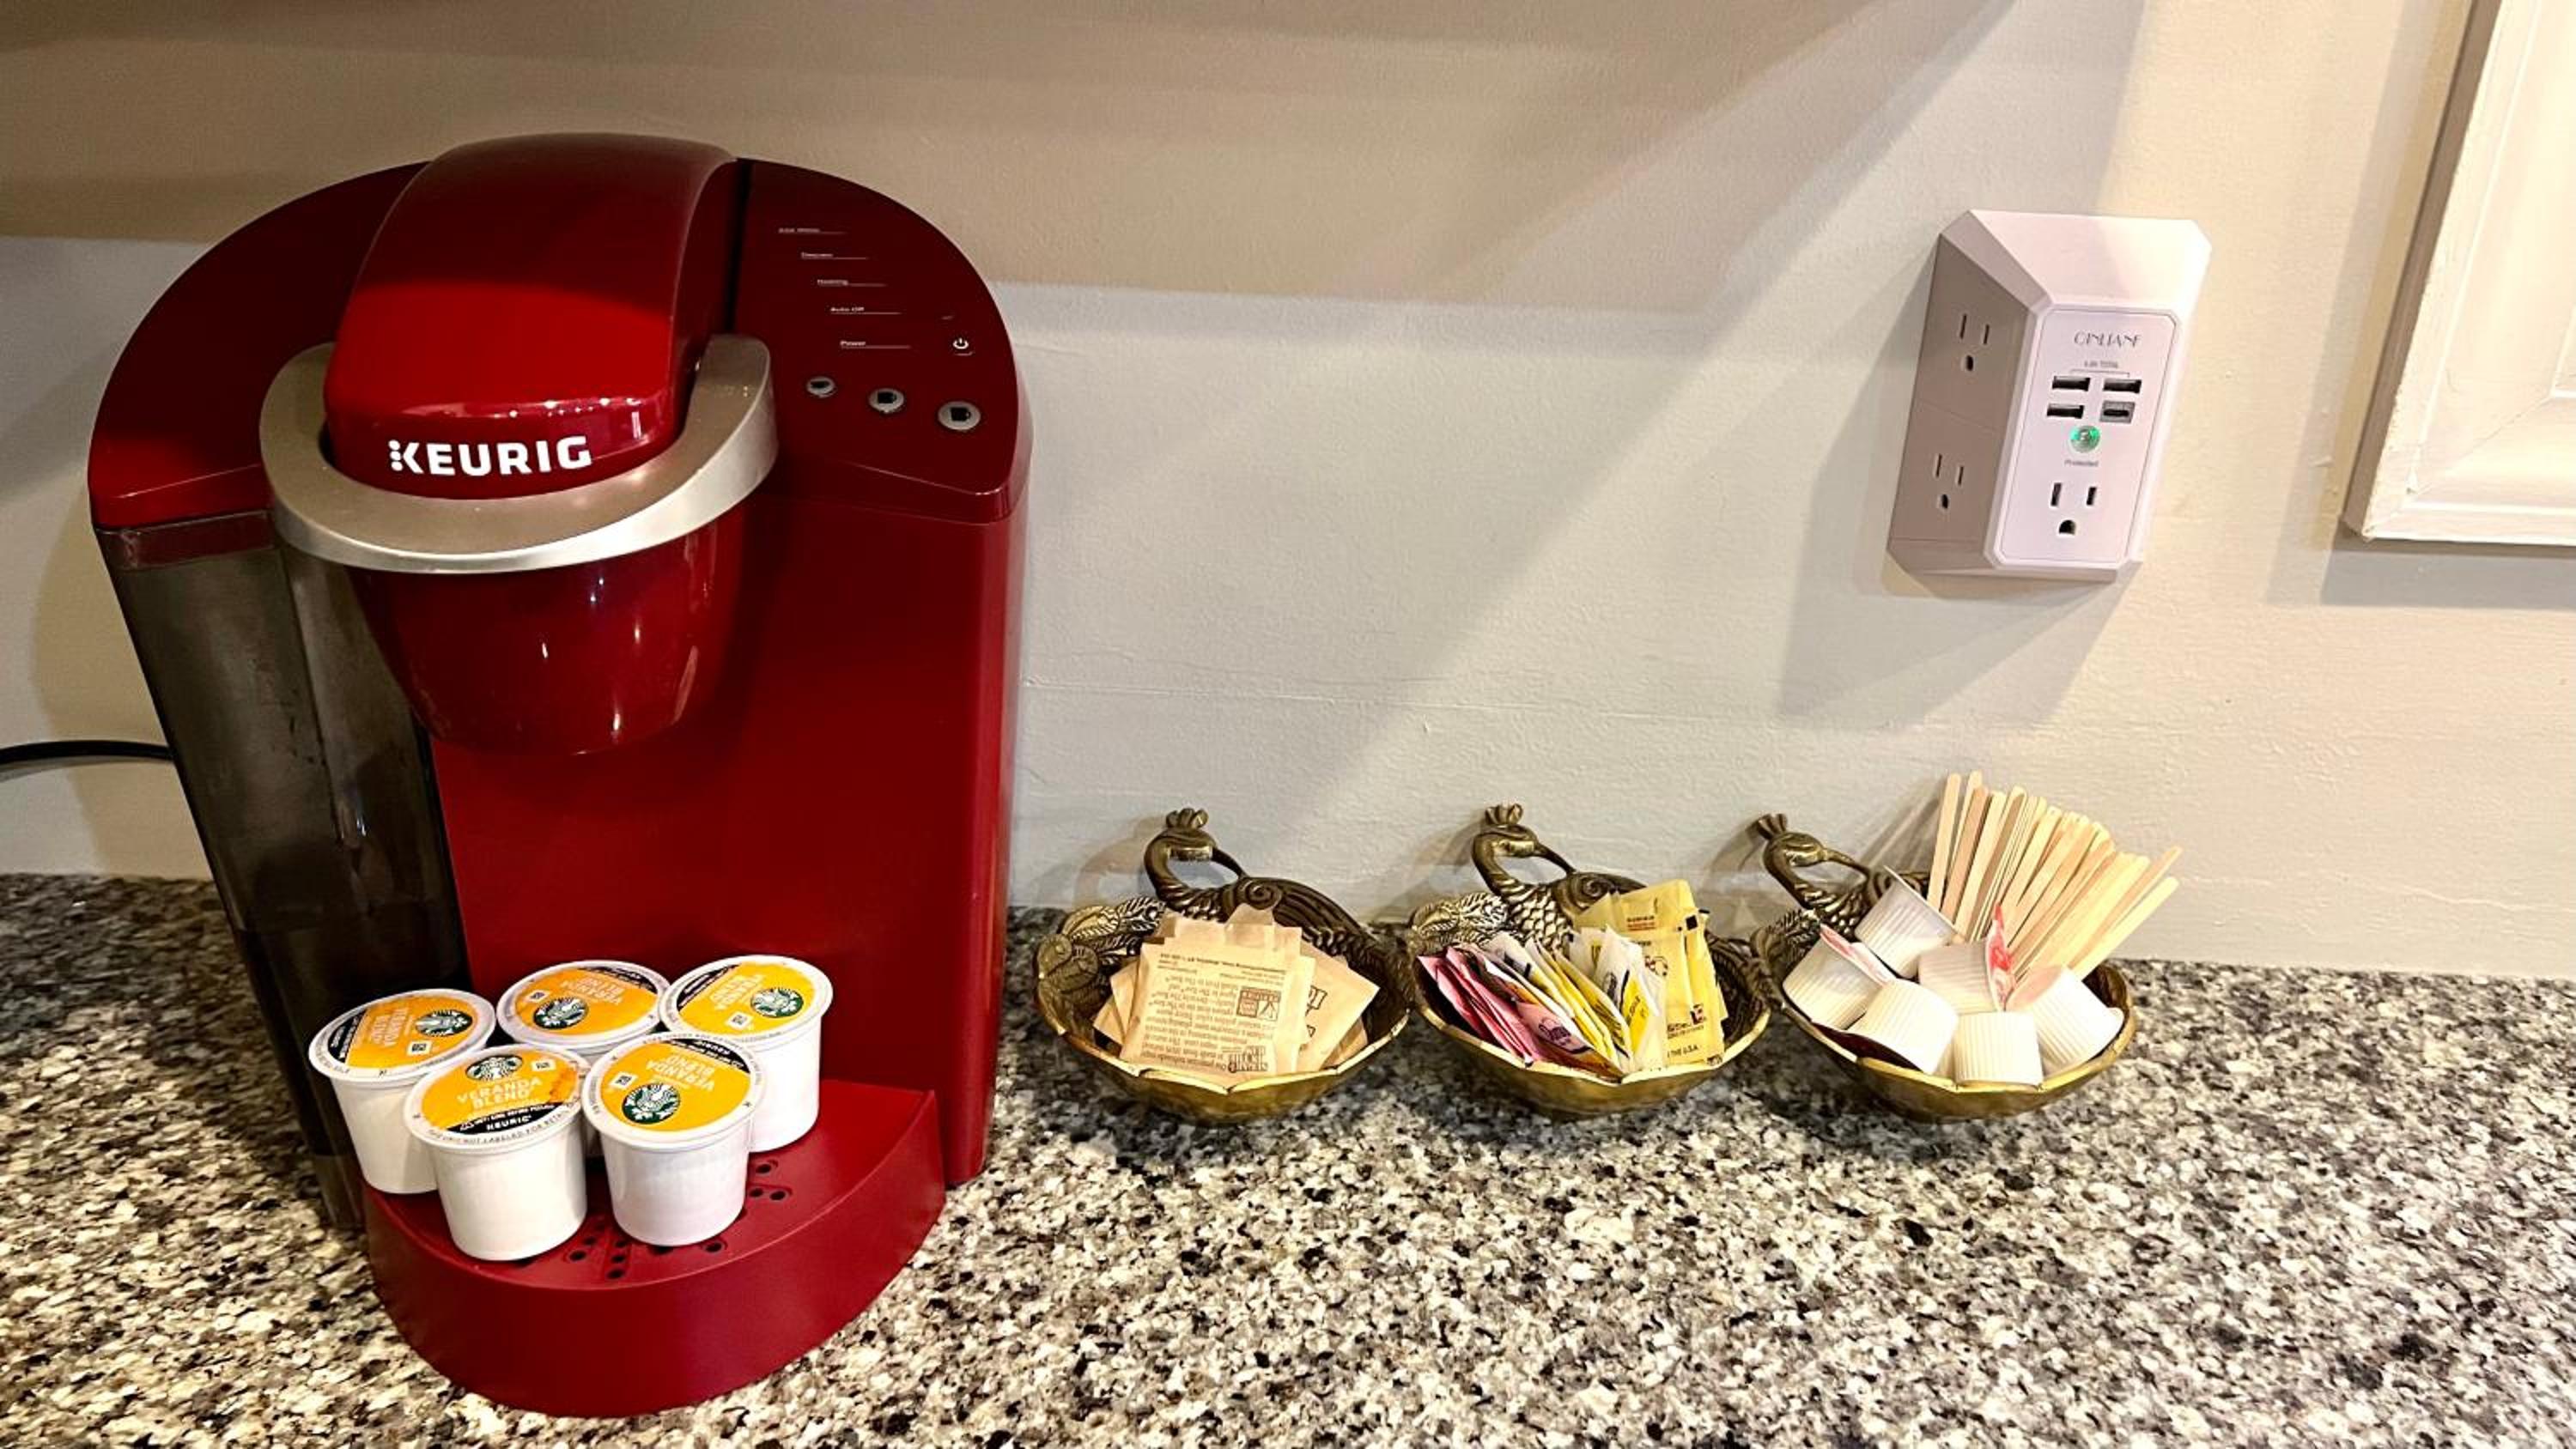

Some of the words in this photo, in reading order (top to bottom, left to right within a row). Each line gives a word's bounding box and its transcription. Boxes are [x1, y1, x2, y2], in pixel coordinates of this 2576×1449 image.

[388, 436, 592, 476] KEURIG
[646, 1059, 715, 1092] VERANDA
[666, 1053, 715, 1075] BLEND
[456, 1077, 544, 1104] VERANDA
[472, 1088, 532, 1110] BLEND
[485, 1117, 529, 1131] KEURIG
